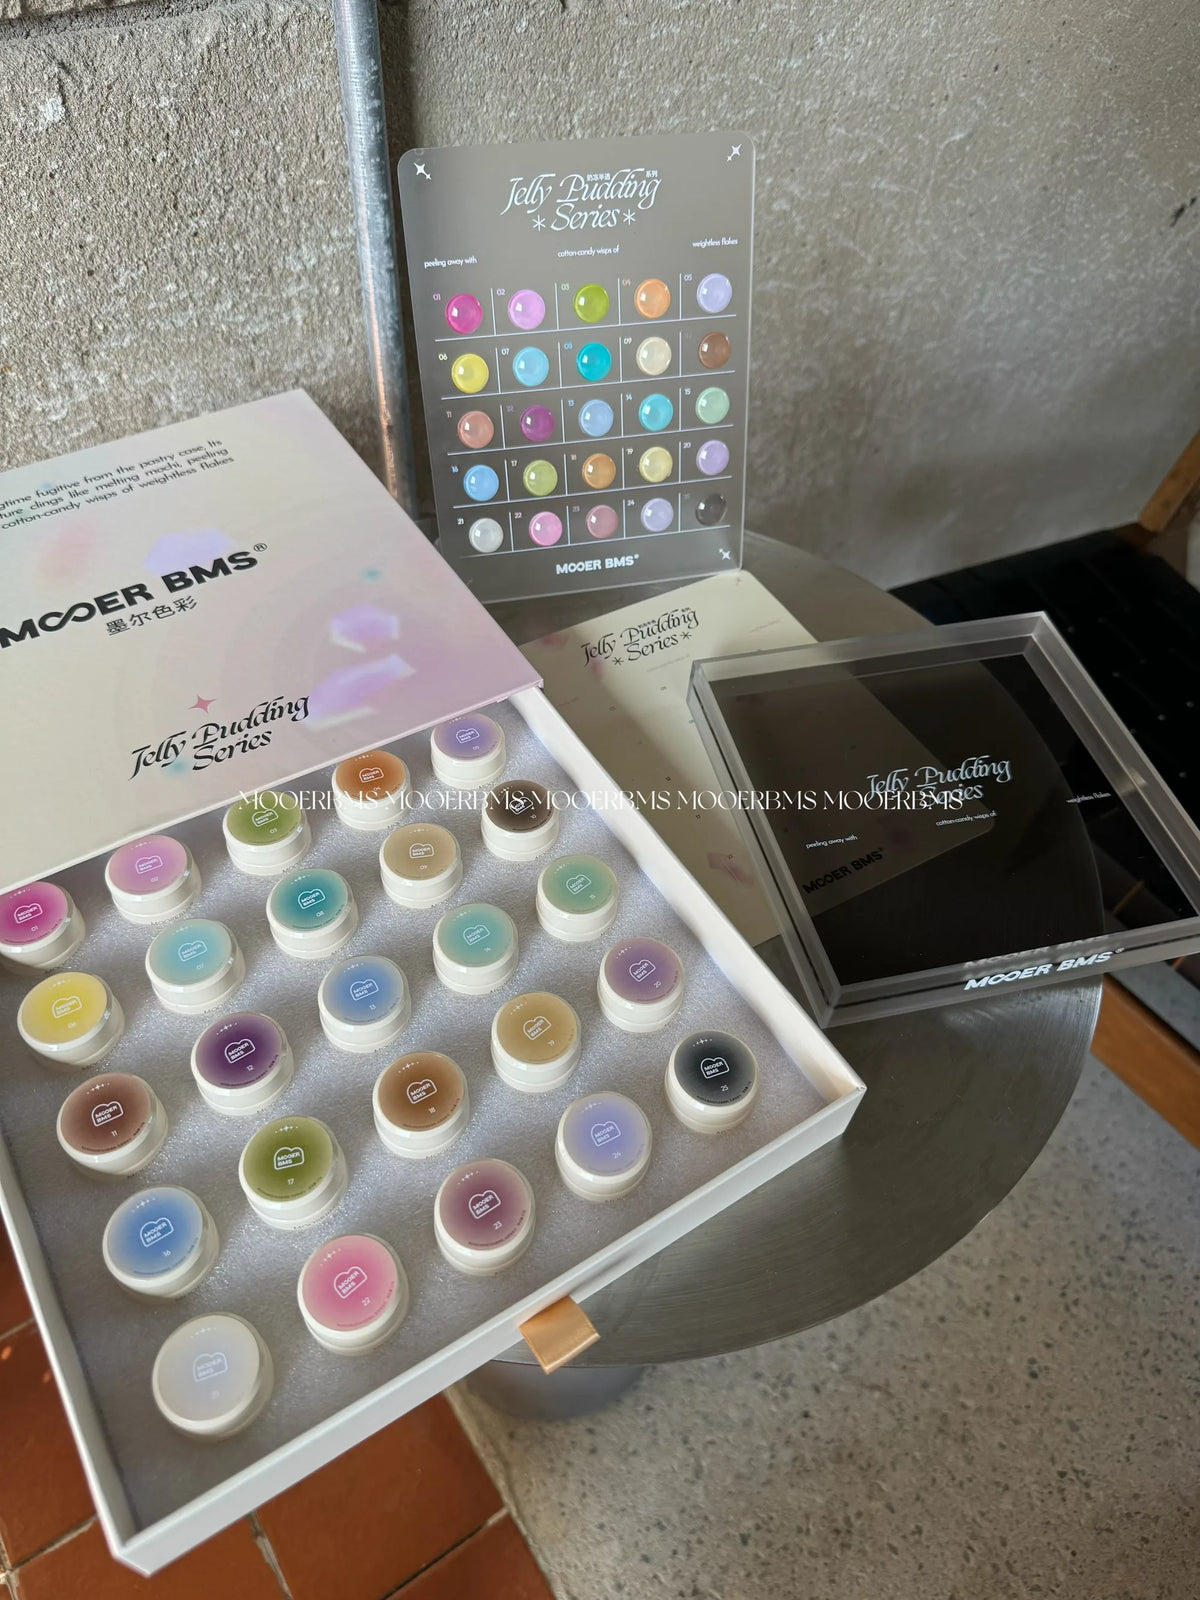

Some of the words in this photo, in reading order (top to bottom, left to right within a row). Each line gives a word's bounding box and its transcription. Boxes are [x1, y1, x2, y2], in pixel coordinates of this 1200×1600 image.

[500, 173, 556, 215] Jelly
[556, 168, 661, 210] Pudding
[551, 203, 620, 231] Series
[612, 244, 620, 253] of
[692, 238, 720, 248] weightless
[424, 258, 446, 269] peeling
[447, 258, 463, 267] away
[464, 255, 477, 265] with
[1, 502, 81, 530] cotton-candy
[85, 491, 118, 504] wisps
[122, 483, 134, 494] of
[139, 468, 198, 489] weightless
[200, 457, 235, 471] flakes
[30, 496, 64, 511] clings
[68, 488, 90, 499] like
[95, 474, 140, 491] melting
[187, 448, 229, 466] peeling
[36, 481, 81, 498] fugitive
[84, 471, 114, 484] from
[116, 465, 136, 475] the
[139, 454, 175, 470] pastry
[555, 559, 602, 575] MOOER
[0, 583, 155, 649] MOOER
[105, 595, 198, 637] 墨尔色彩
[580, 632, 616, 668] Jelly
[620, 608, 699, 647] Pudding
[626, 633, 679, 662] Series
[128, 730, 187, 782] Jelly
[191, 695, 310, 749] Pudding
[192, 730, 273, 771] Series
[867, 768, 909, 802] Jelly
[914, 755, 1012, 787] Pudding
[802, 865, 853, 895] MOOER
[963, 962, 1054, 991] MOOER
[703, 1061, 724, 1071] MOOER
[277, 1152, 300, 1161] MOOER
